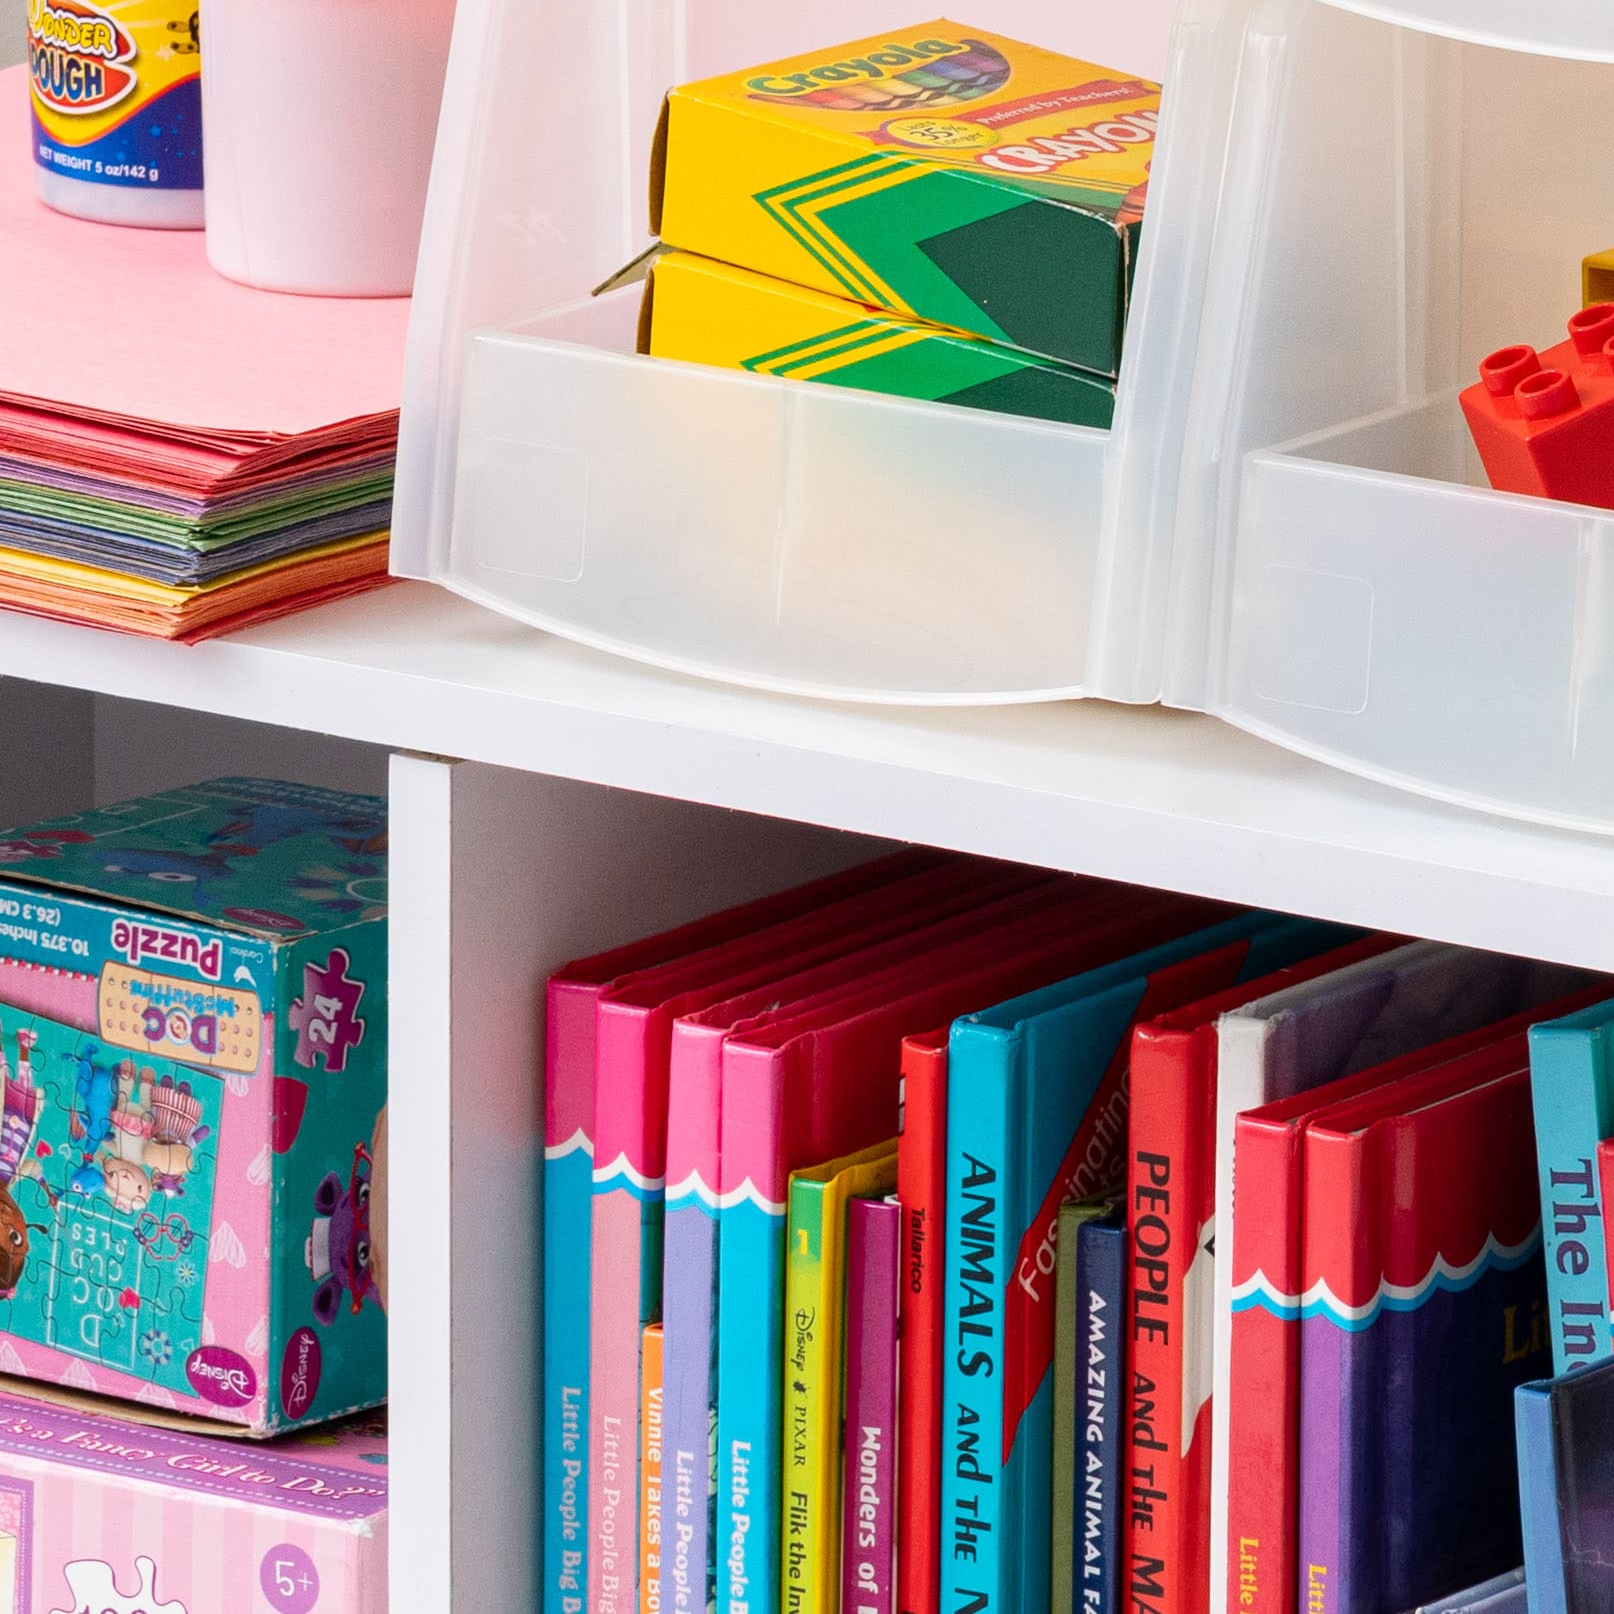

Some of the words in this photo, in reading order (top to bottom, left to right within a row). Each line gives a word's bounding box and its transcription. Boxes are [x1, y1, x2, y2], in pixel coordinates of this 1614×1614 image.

[747, 39, 963, 94] Crayola
[976, 102, 1041, 125] Preferred
[1040, 99, 1061, 114] by
[39, 144, 52, 159] NET
[54, 149, 92, 172] WEIGHT
[95, 161, 103, 174] 5
[105, 163, 146, 179] oz/142
[23, 902, 61, 927] (26.3
[41, 933, 90, 957] 10.375
[115, 922, 221, 978] Puzzle
[143, 1005, 218, 1055] DOC
[309, 994, 343, 1046] 24
[1134, 1151, 1170, 1345] PEOPLE
[1549, 1158, 1600, 1277] The
[910, 1208, 926, 1294] Tallarico
[956, 1152, 997, 1379] ANIMALS
[791, 1307, 815, 1371] Disney
[1084, 1289, 1107, 1442] AMAZING
[190, 1354, 253, 1400] Disney
[286, 1333, 314, 1415] Disney
[562, 1386, 582, 1453] Little
[603, 1415, 621, 1482] Little
[794, 1406, 807, 1467] PIXAR
[60, 1430, 157, 1461] Fancy
[167, 1454, 248, 1482] Girl
[240, 1466, 277, 1485] to
[676, 1449, 695, 1518] Little
[731, 1438, 751, 1509] Little
[859, 1426, 882, 1548] Wonders
[559, 1459, 582, 1541] People
[599, 1487, 621, 1571] People
[791, 1490, 807, 1536] Flik
[1082, 1451, 1104, 1579] ANIMAL
[274, 1560, 313, 1598] 5+
[559, 1550, 582, 1590] Big
[647, 1556, 660, 1568] a
[673, 1524, 694, 1606] People
[727, 1512, 750, 1597] People
[789, 1542, 807, 1578] the
[858, 1563, 879, 1595] of
[1239, 1536, 1259, 1605] Little
[598, 1576, 619, 1614] Big
